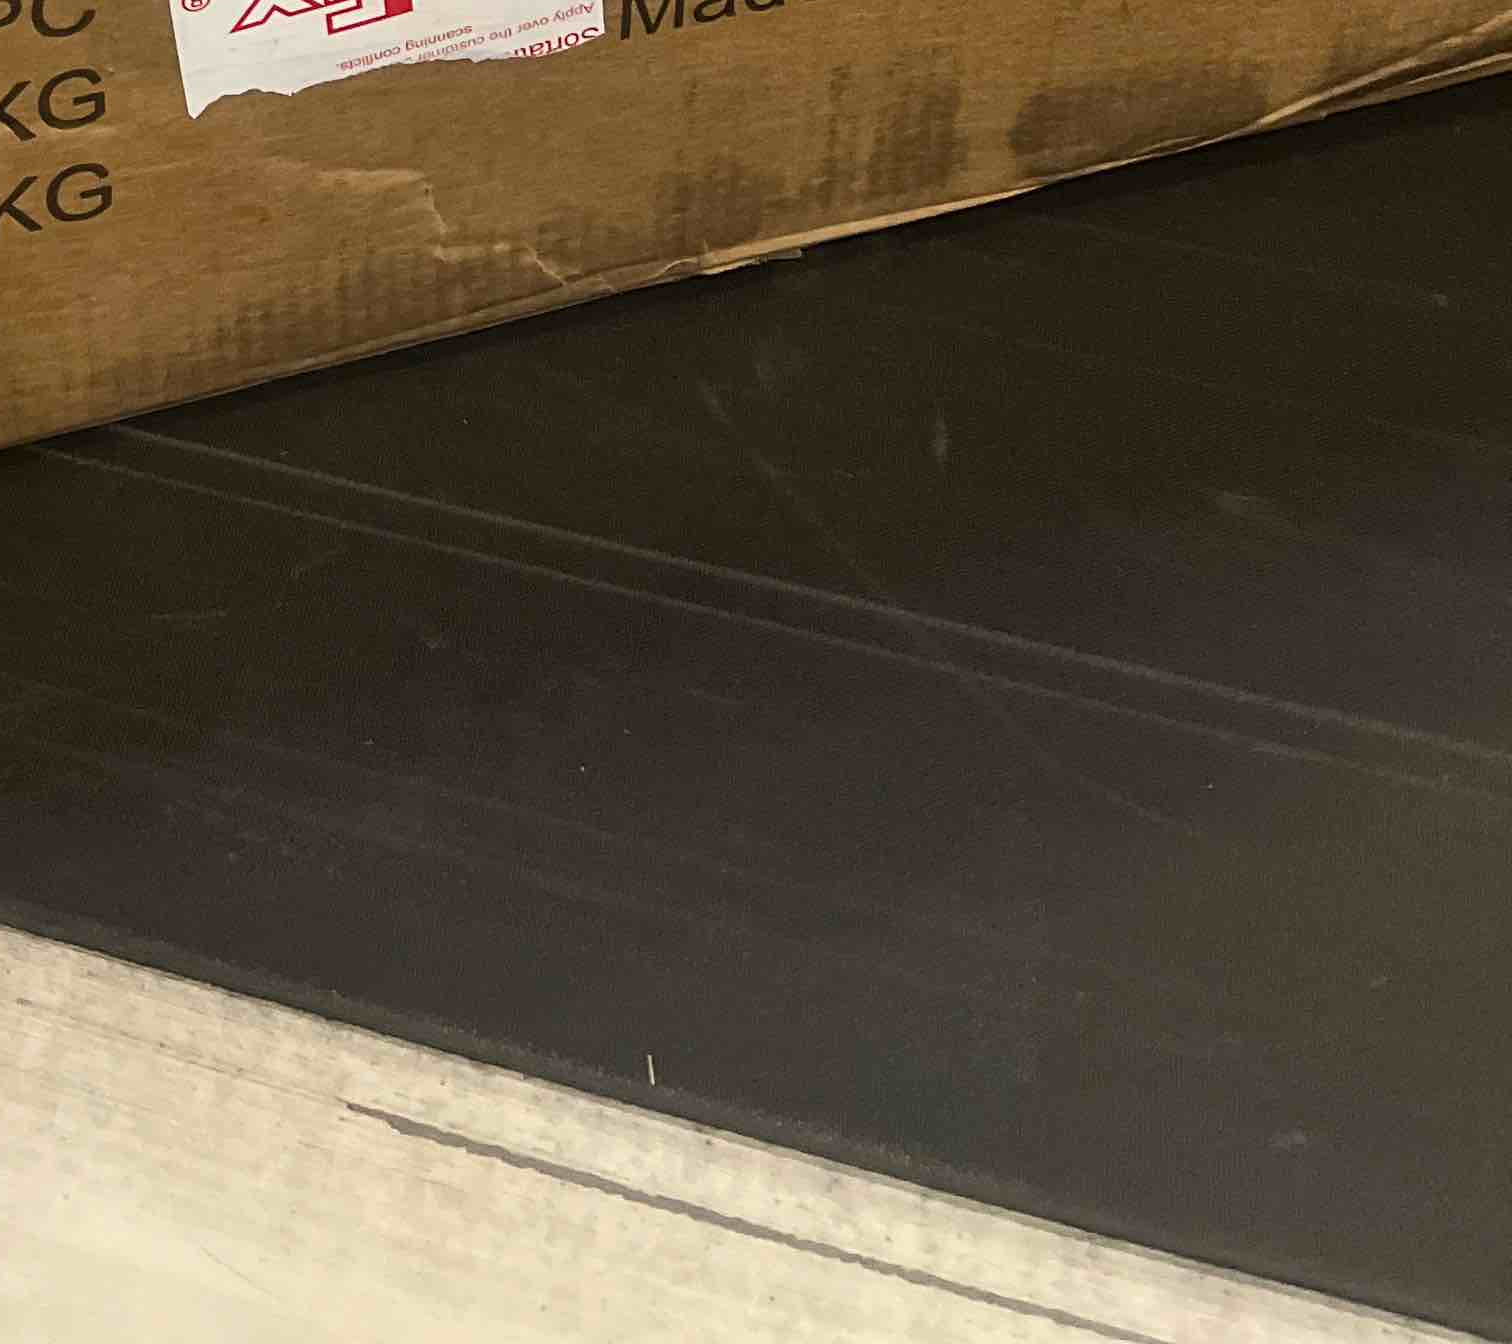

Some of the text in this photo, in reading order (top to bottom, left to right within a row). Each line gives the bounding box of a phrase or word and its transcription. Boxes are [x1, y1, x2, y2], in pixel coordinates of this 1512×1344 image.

[552, 0, 594, 23] Apply
[489, 26, 511, 43] the
[516, 14, 549, 34] over
[405, 24, 473, 50] scanning
